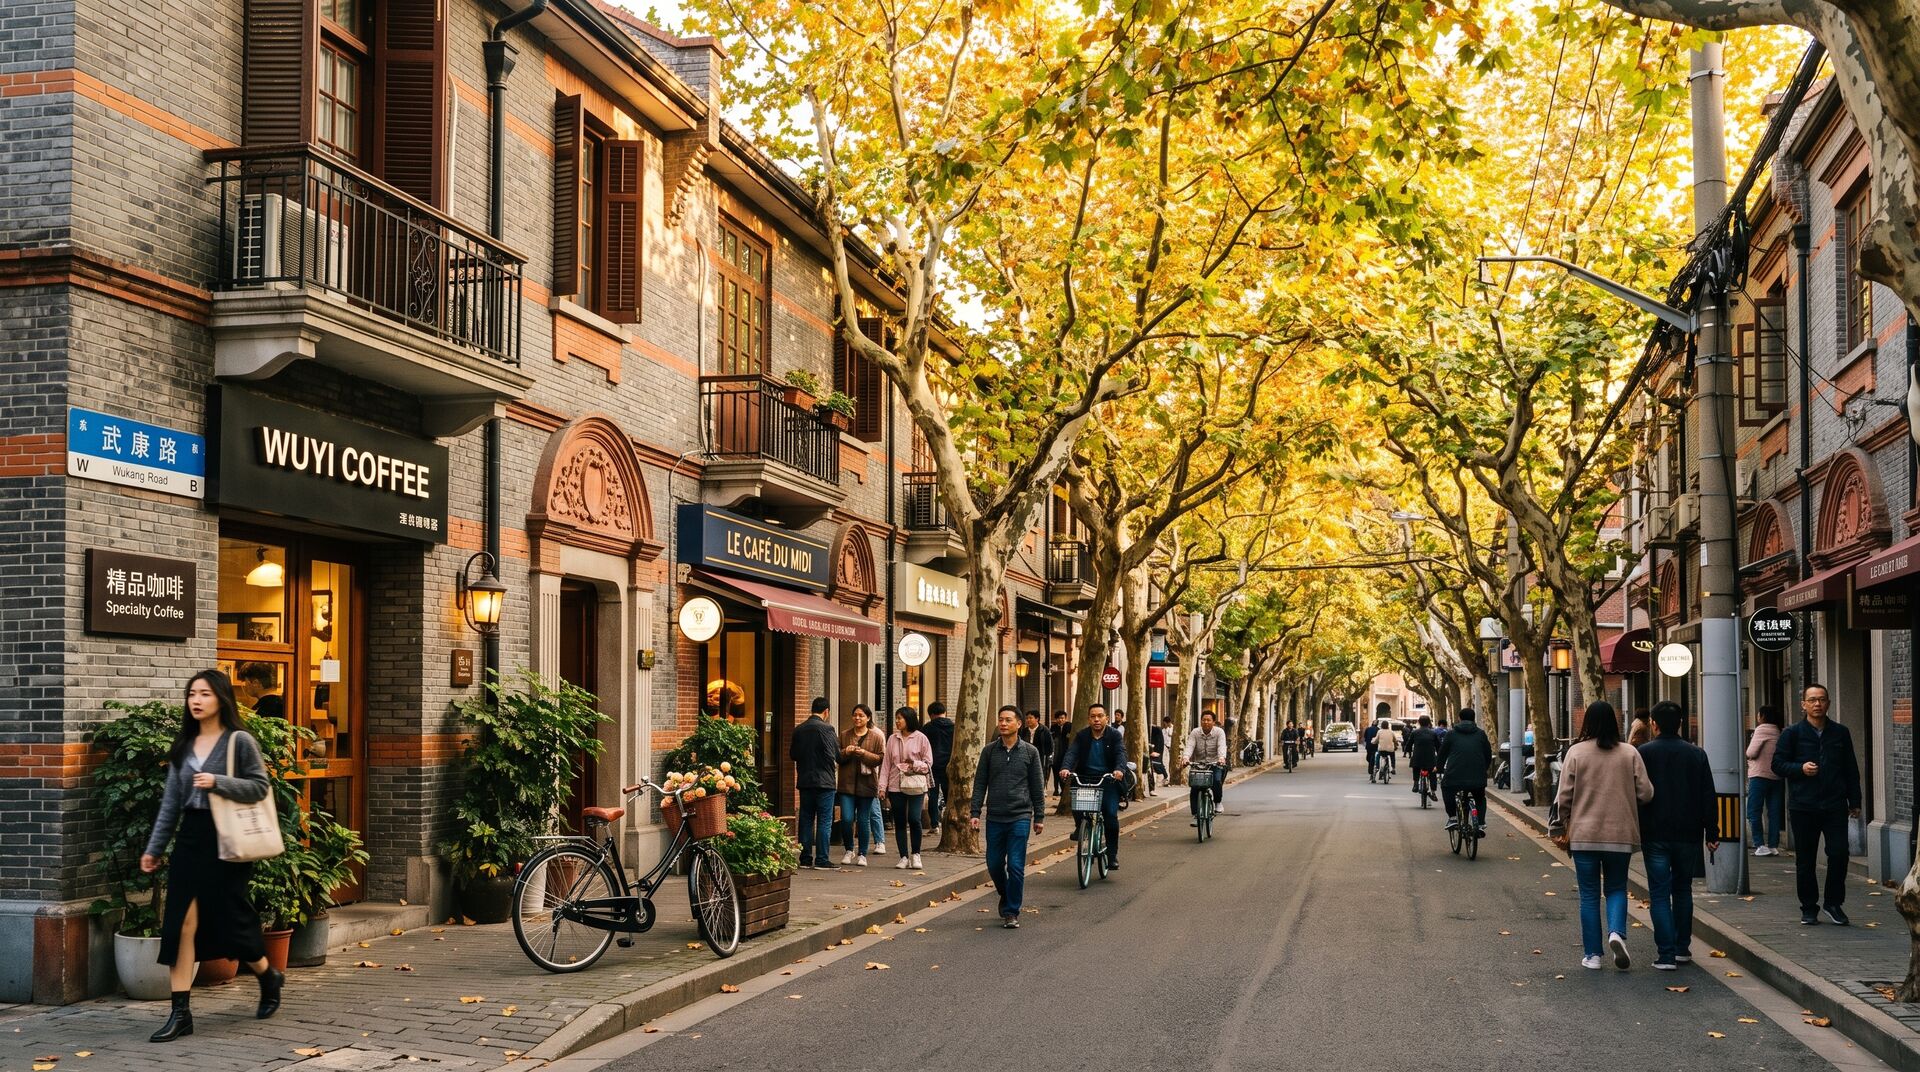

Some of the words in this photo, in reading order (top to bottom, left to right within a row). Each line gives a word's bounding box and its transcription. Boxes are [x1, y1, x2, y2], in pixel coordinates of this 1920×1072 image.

[102, 425, 178, 464] 武康路
[77, 458, 89, 472] W
[113, 465, 145, 484] Wukang
[147, 471, 168, 485] Road
[263, 426, 334, 477] WUYI
[342, 447, 430, 499] COFFEE
[190, 480, 198, 492] B
[727, 530, 741, 556] LE
[743, 537, 771, 564] CAFÉ
[773, 543, 788, 568] DU
[791, 548, 812, 574] MIDI
[106, 567, 184, 600] 精品咖啡
[106, 600, 151, 619] Specialty
[153, 604, 184, 619] Coffee
